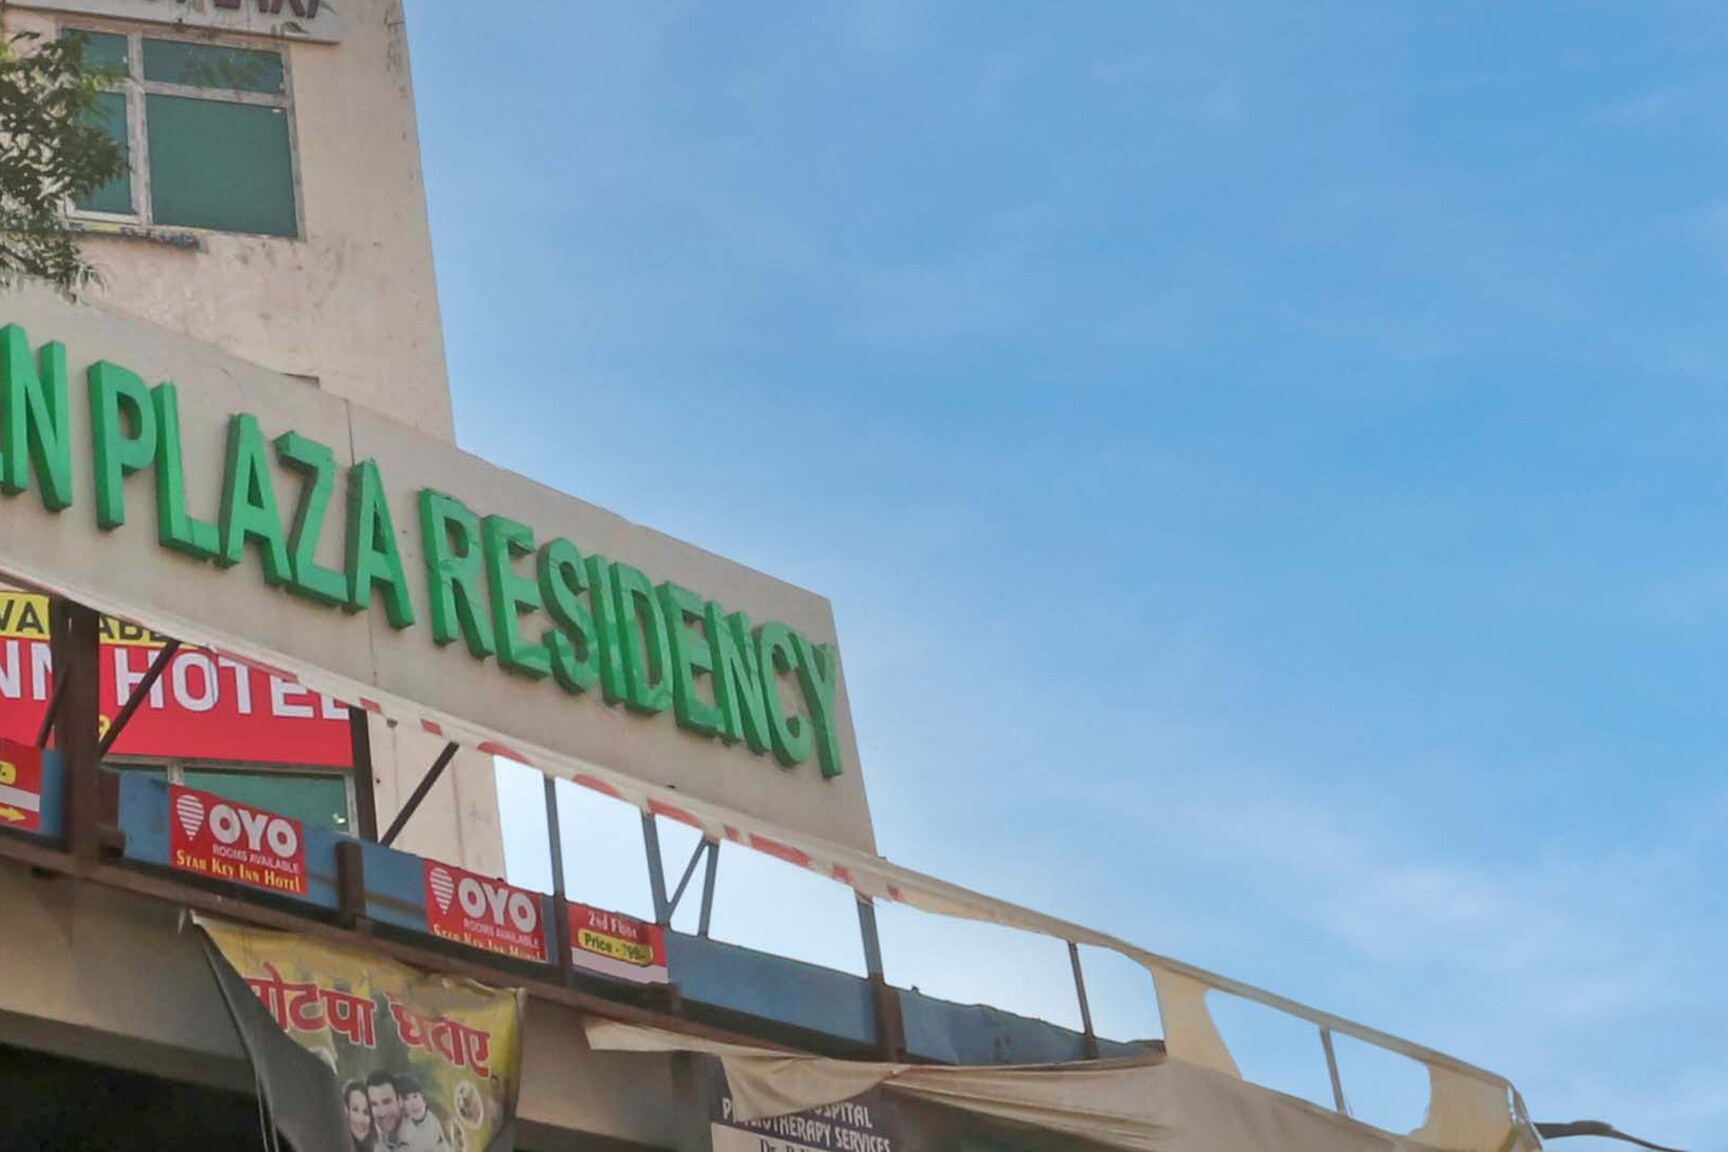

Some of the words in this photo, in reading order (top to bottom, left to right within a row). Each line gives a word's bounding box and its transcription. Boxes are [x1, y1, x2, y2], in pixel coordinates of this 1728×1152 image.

[85, 359, 415, 629] PLAZA
[419, 487, 843, 778] RESIDENCY
[209, 803, 298, 859] OYO
[458, 877, 537, 934] OYO
[585, 933, 613, 953] Price
[808, 1102, 874, 1130] SPITAL
